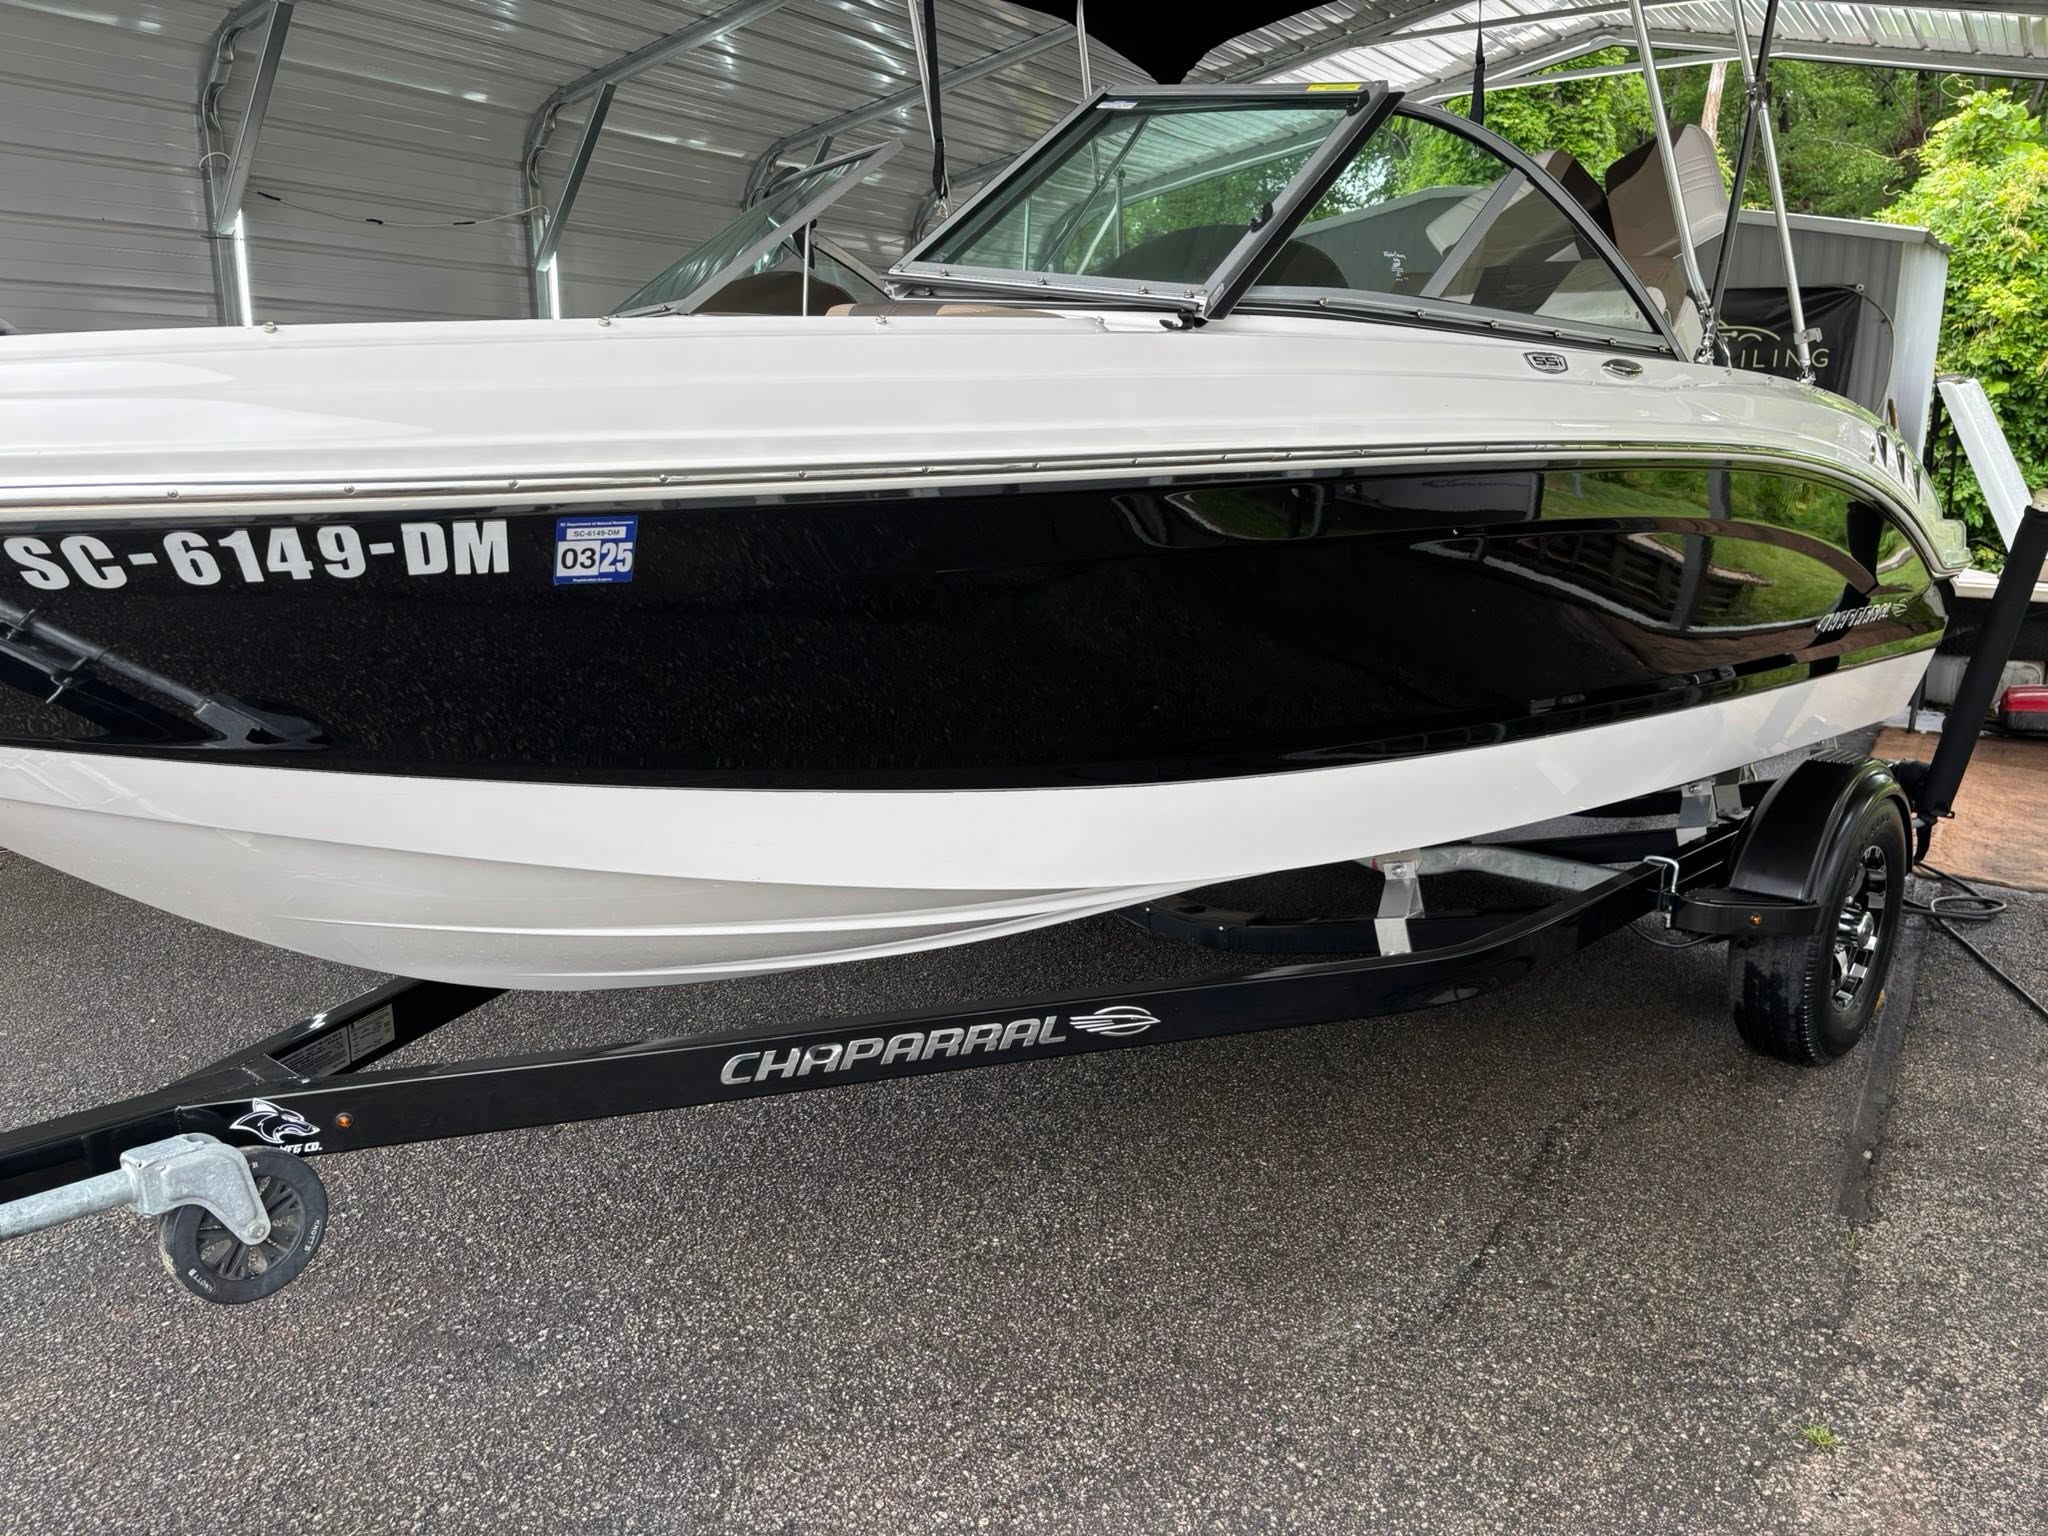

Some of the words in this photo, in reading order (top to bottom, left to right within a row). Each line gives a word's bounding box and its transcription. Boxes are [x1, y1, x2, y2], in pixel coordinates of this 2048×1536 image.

[1740, 348, 1829, 368] ILING
[573, 529, 620, 537] SC-6149-DM
[3, 519, 510, 590] SC-6149-DM
[561, 547, 597, 570] 03
[599, 542, 633, 573] 25
[719, 1015, 1067, 1085] CHAPARRAL
